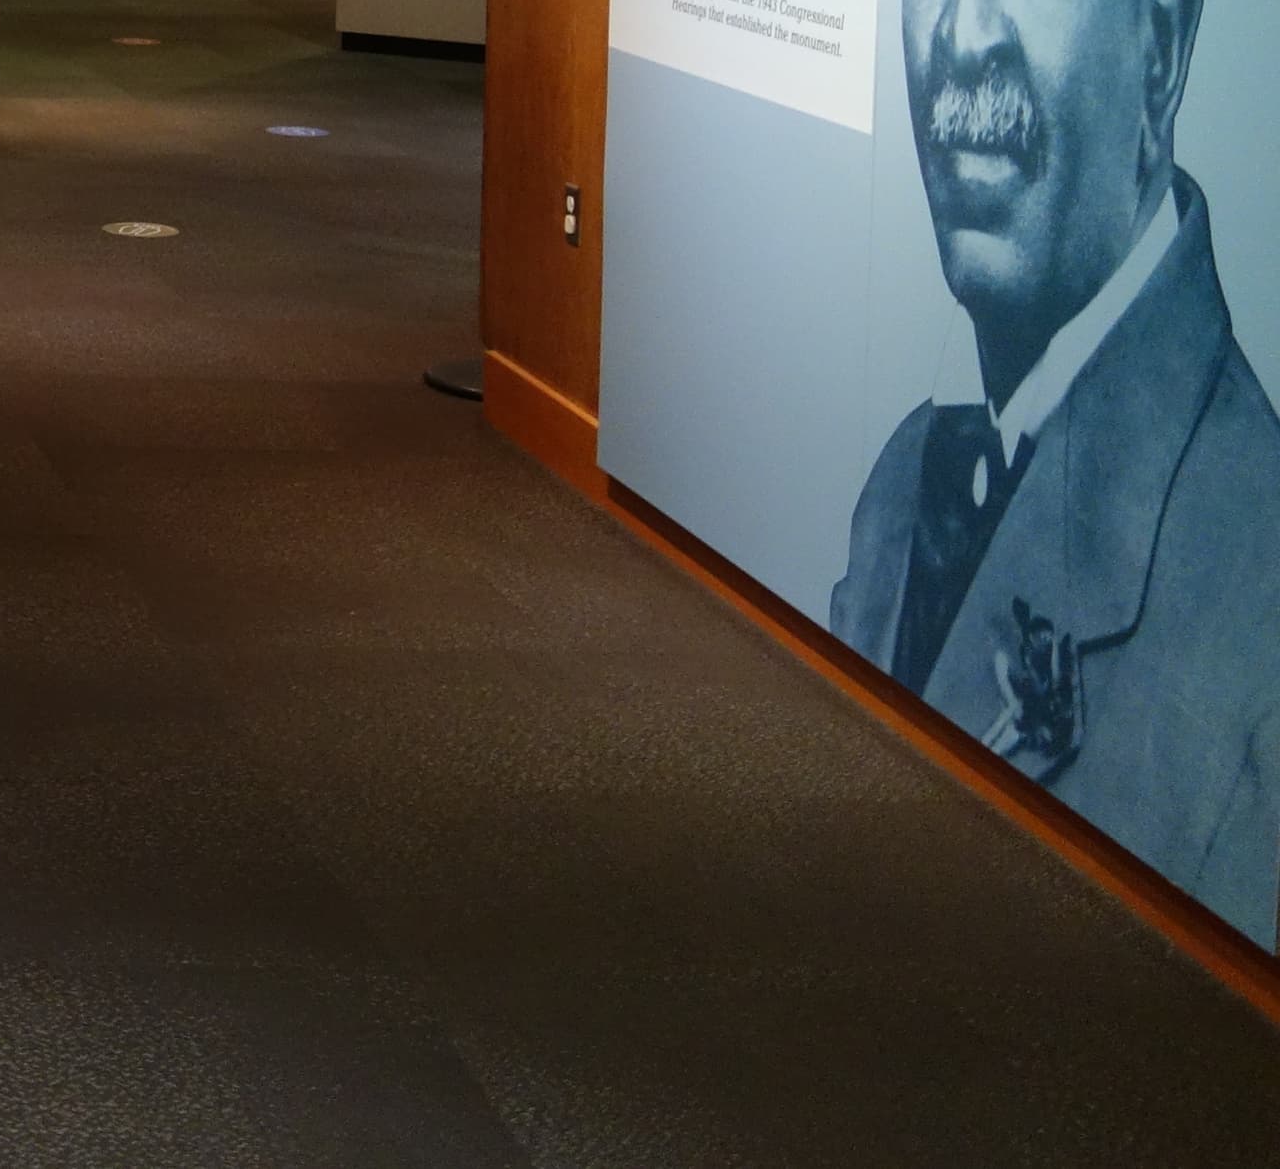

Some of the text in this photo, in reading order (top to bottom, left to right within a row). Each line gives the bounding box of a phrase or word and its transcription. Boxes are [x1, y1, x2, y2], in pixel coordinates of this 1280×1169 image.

[708, 5, 724, 23] that
[726, 13, 772, 37] established
[774, 23, 788, 42] the
[790, 32, 841, 57] monument.
